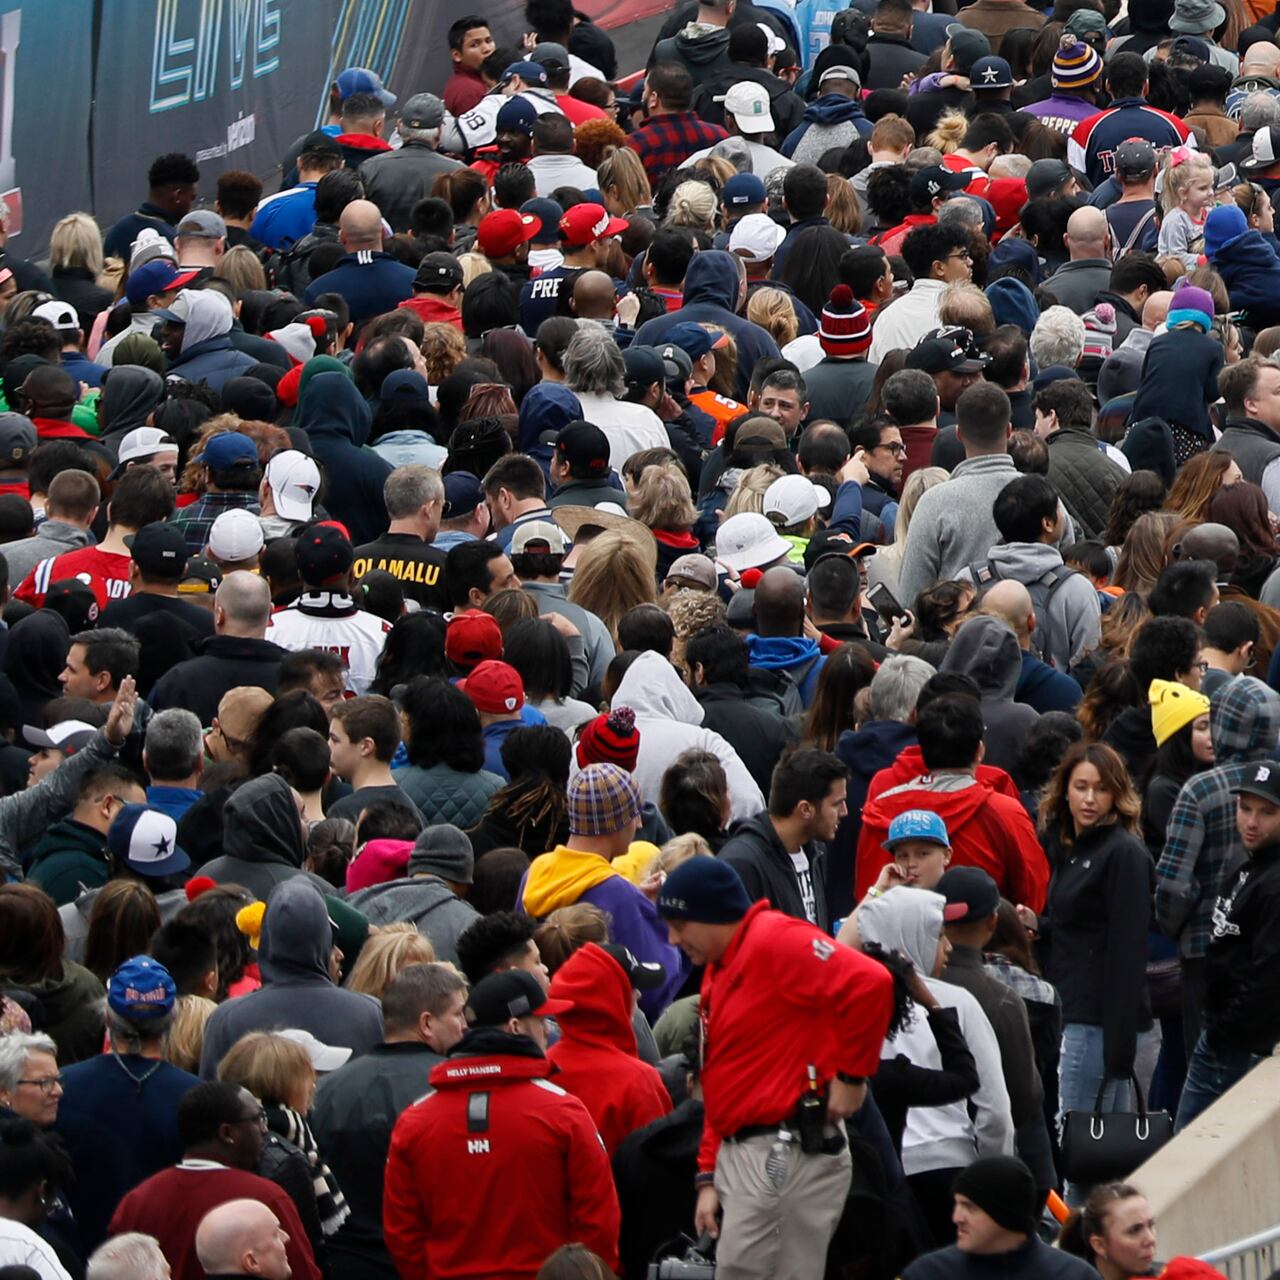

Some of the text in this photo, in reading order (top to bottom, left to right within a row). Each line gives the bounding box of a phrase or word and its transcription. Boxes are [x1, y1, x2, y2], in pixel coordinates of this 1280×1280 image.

[353, 558, 440, 586] OLAMALU
[468, 1065, 501, 1076] HANSEN
[468, 1139, 490, 1155] HH
